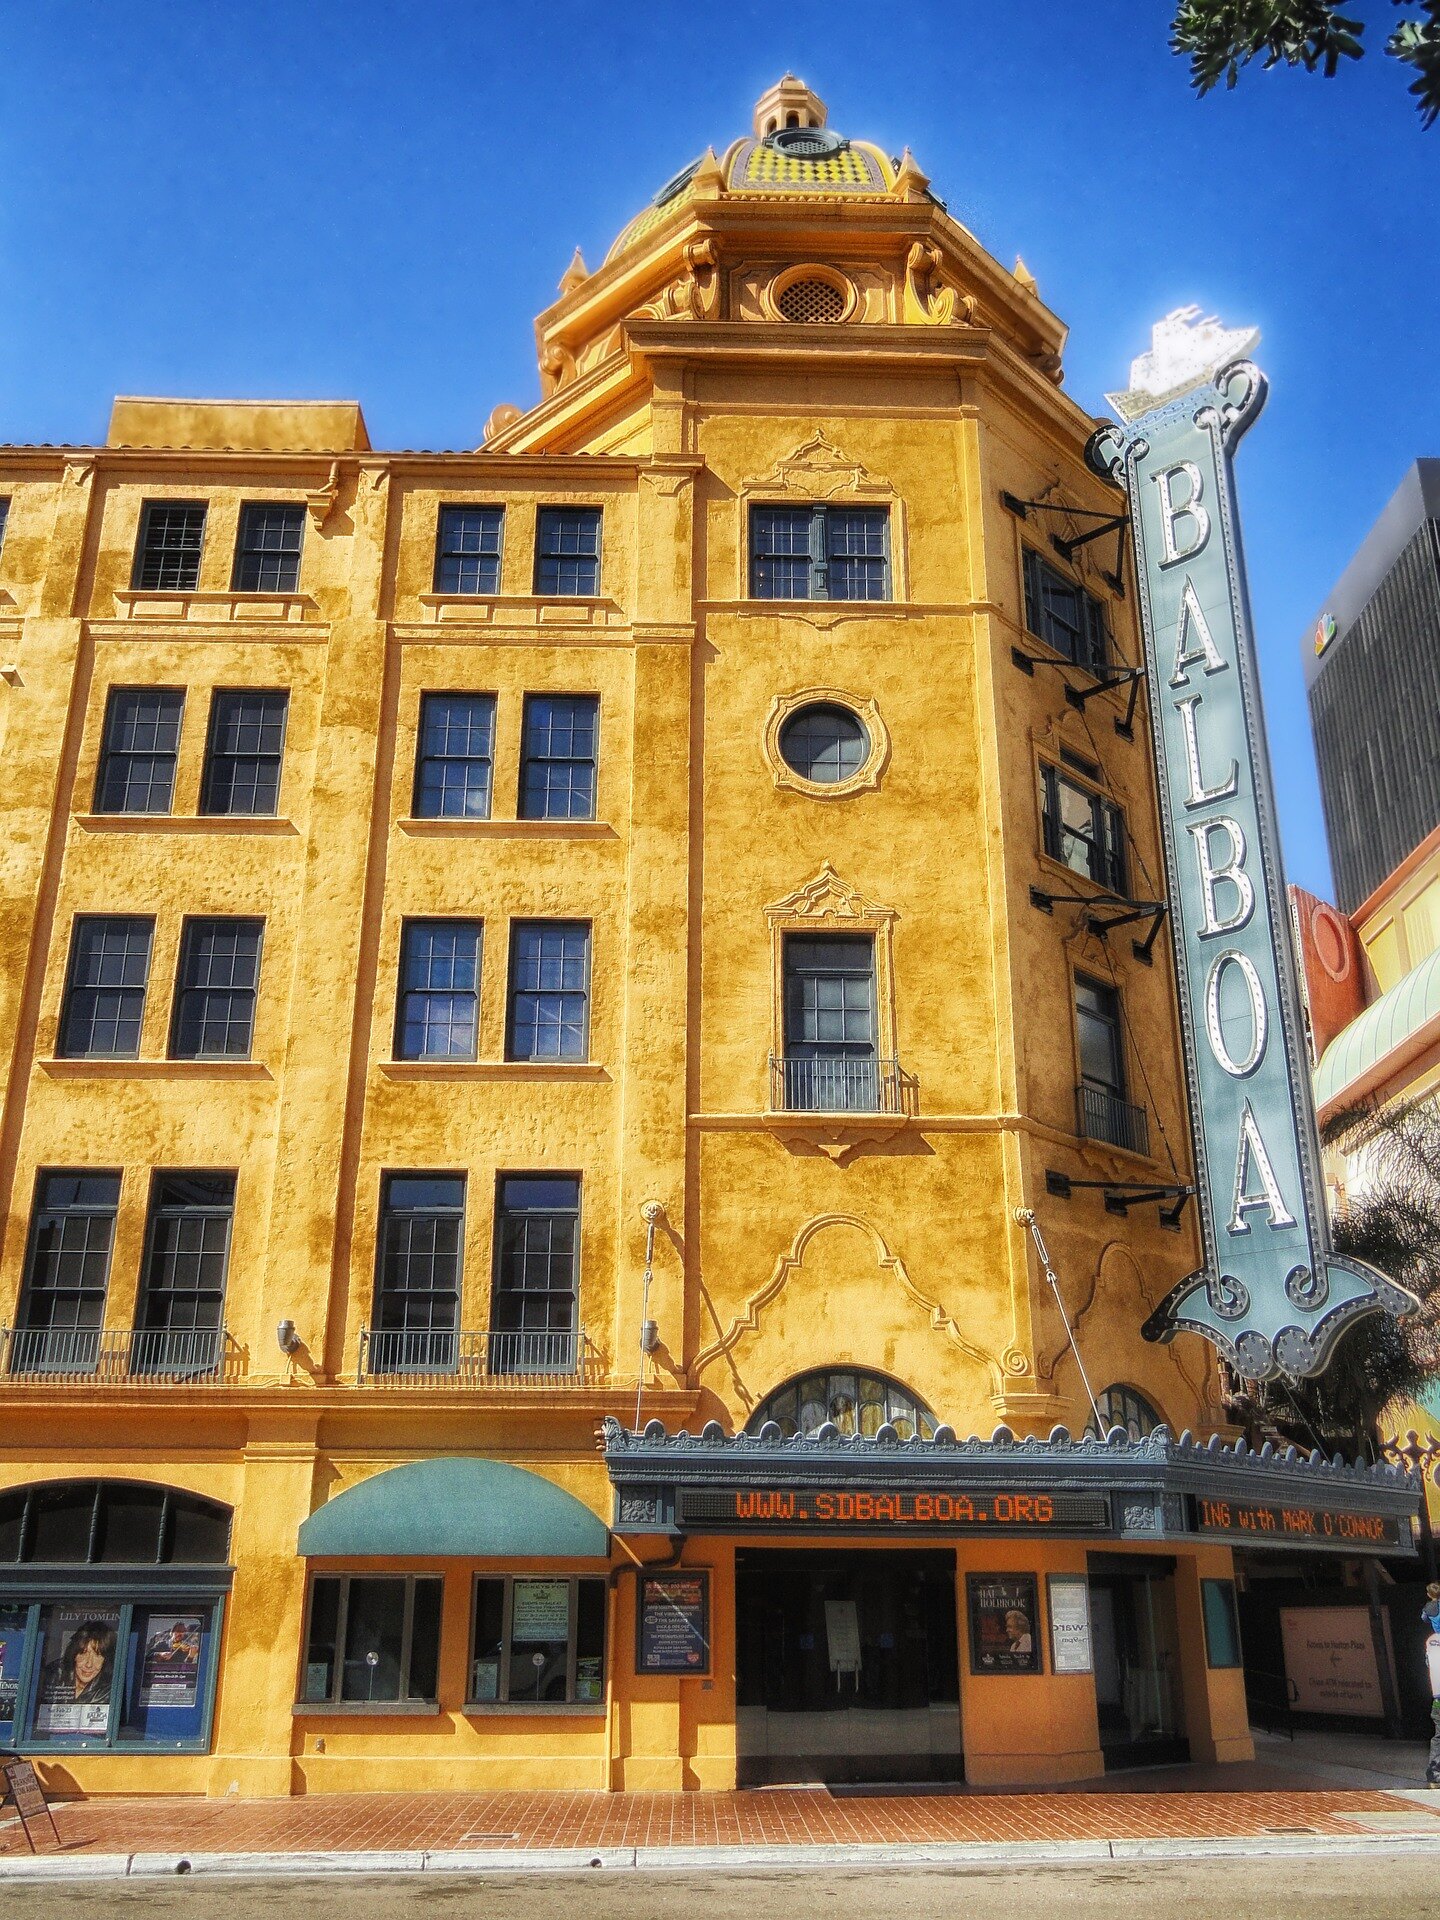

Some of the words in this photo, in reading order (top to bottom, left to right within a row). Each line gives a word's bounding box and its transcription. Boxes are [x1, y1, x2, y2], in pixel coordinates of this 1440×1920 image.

[1149, 458, 1297, 1237] BALBOA
[736, 1491, 1053, 1522] WWW.SDBALBOA.ORG
[1202, 1501, 1231, 1528] ING
[1238, 1506, 1276, 1531] with
[1281, 1508, 1317, 1535] MARK
[1323, 1513, 1385, 1540] O'CONNOR
[60, 1612, 82, 1621] LILY
[83, 1612, 121, 1621] TOMLIN
[980, 1598, 1026, 1608] HOLBROOK
